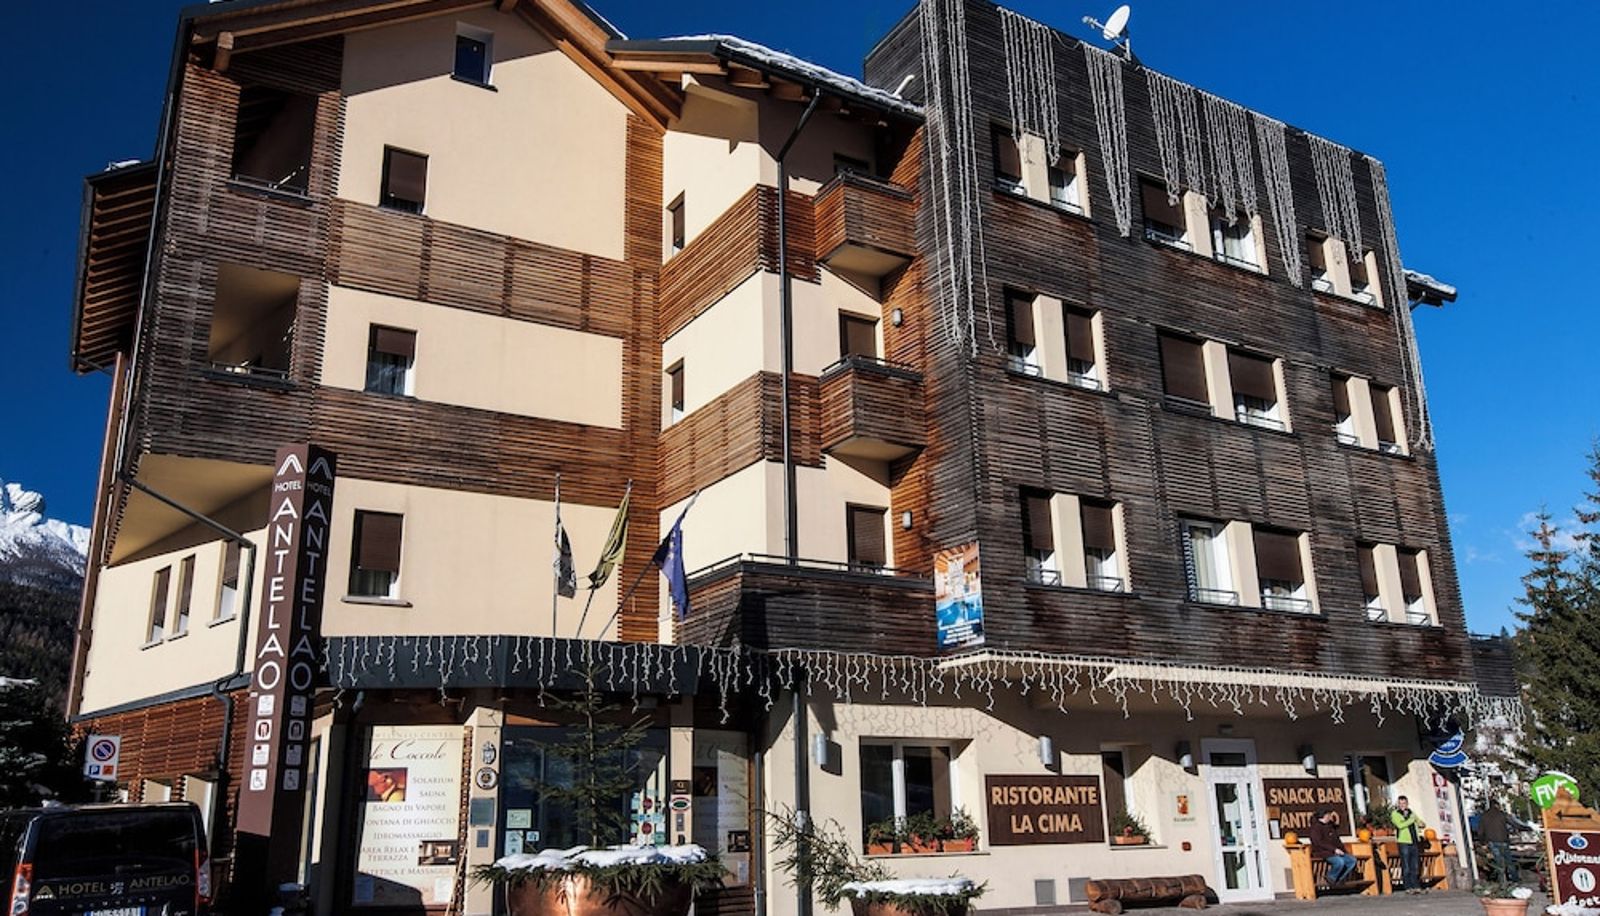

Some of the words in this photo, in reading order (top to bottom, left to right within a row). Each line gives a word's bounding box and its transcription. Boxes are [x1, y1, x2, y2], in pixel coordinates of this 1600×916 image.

[274, 480, 302, 492] HOTEL
[307, 481, 331, 496] HOTEL
[257, 497, 298, 690] ANTELAO
[290, 500, 328, 690] ANTELAO
[991, 786, 1097, 805] RISTORANTE
[1269, 787, 1316, 804] SNACK
[1317, 787, 1344, 803] BAR
[1011, 815, 1034, 834] LA
[1038, 814, 1083, 833] CIMA
[1280, 811, 1340, 829] ANTEO
[58, 881, 106, 895] HOTEL
[129, 874, 190, 888] ANTELAO
